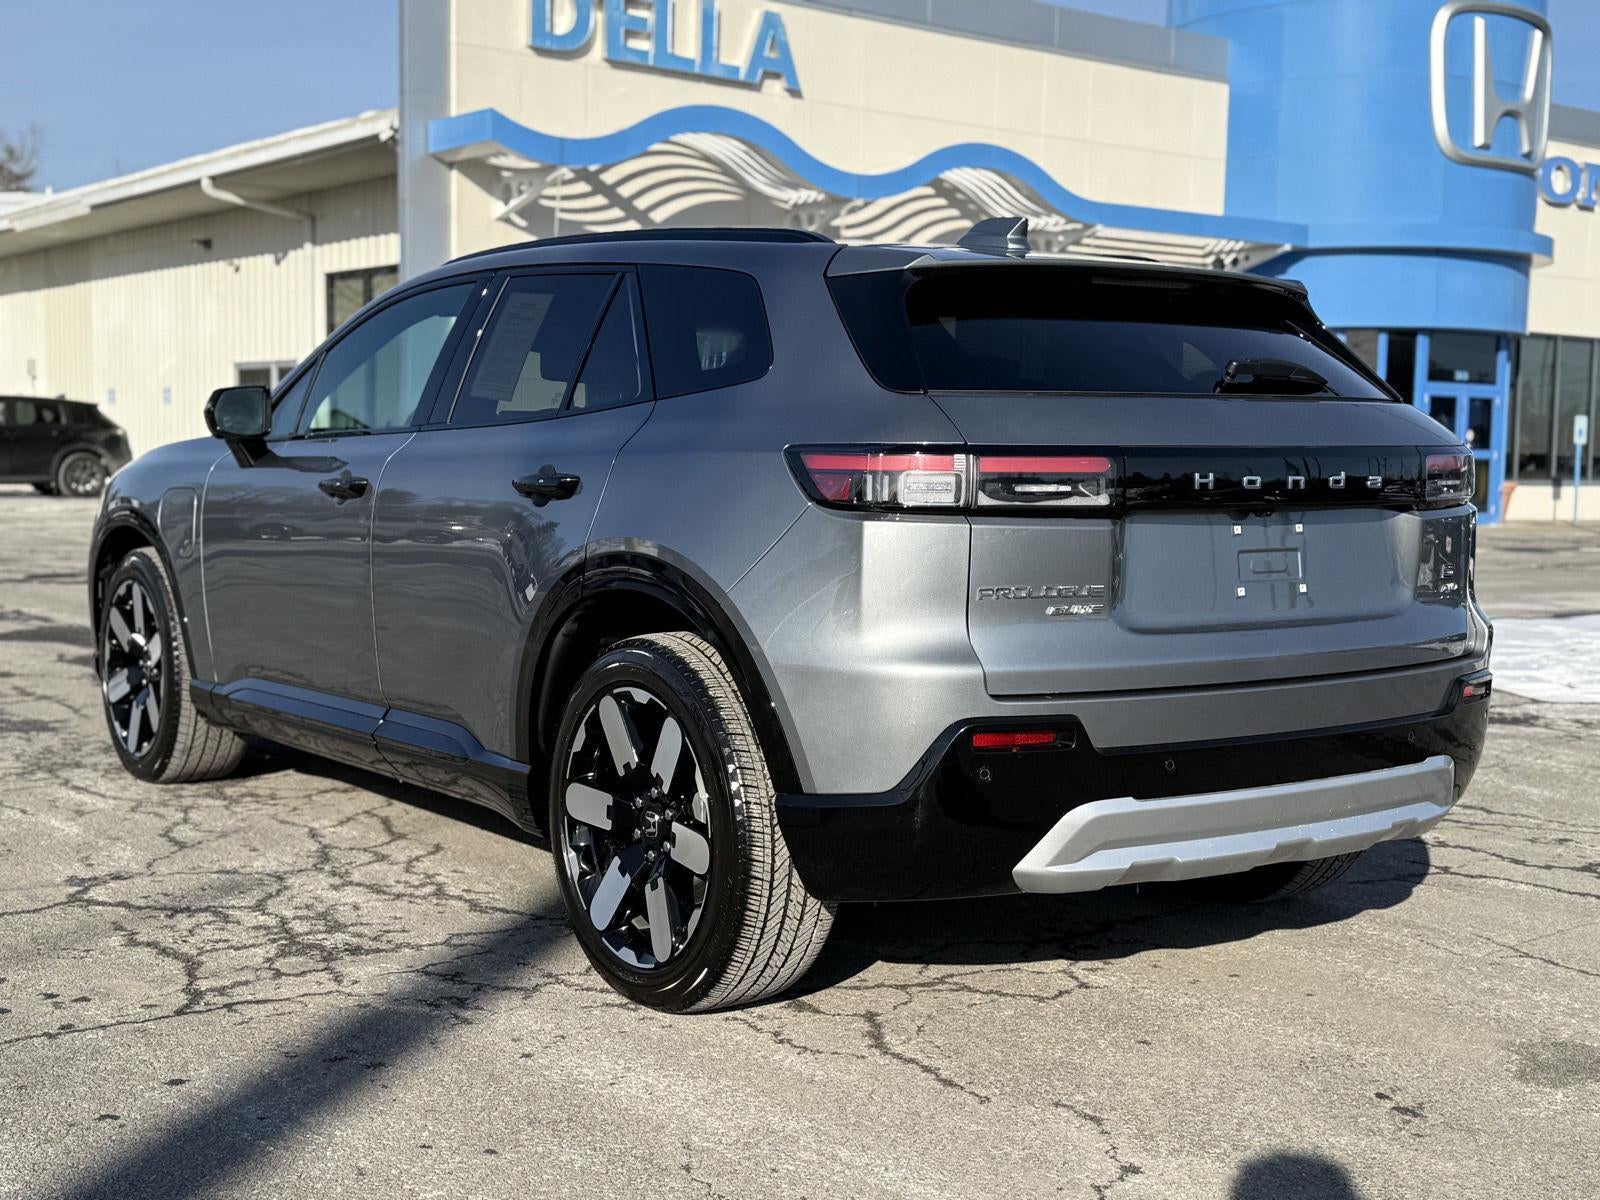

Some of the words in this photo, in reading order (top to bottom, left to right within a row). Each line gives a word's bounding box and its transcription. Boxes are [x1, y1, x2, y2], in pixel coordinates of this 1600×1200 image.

[528, 0, 802, 92] DELLA
[1194, 471, 1383, 490] Honda
[978, 584, 1105, 601] PROLOGUE
